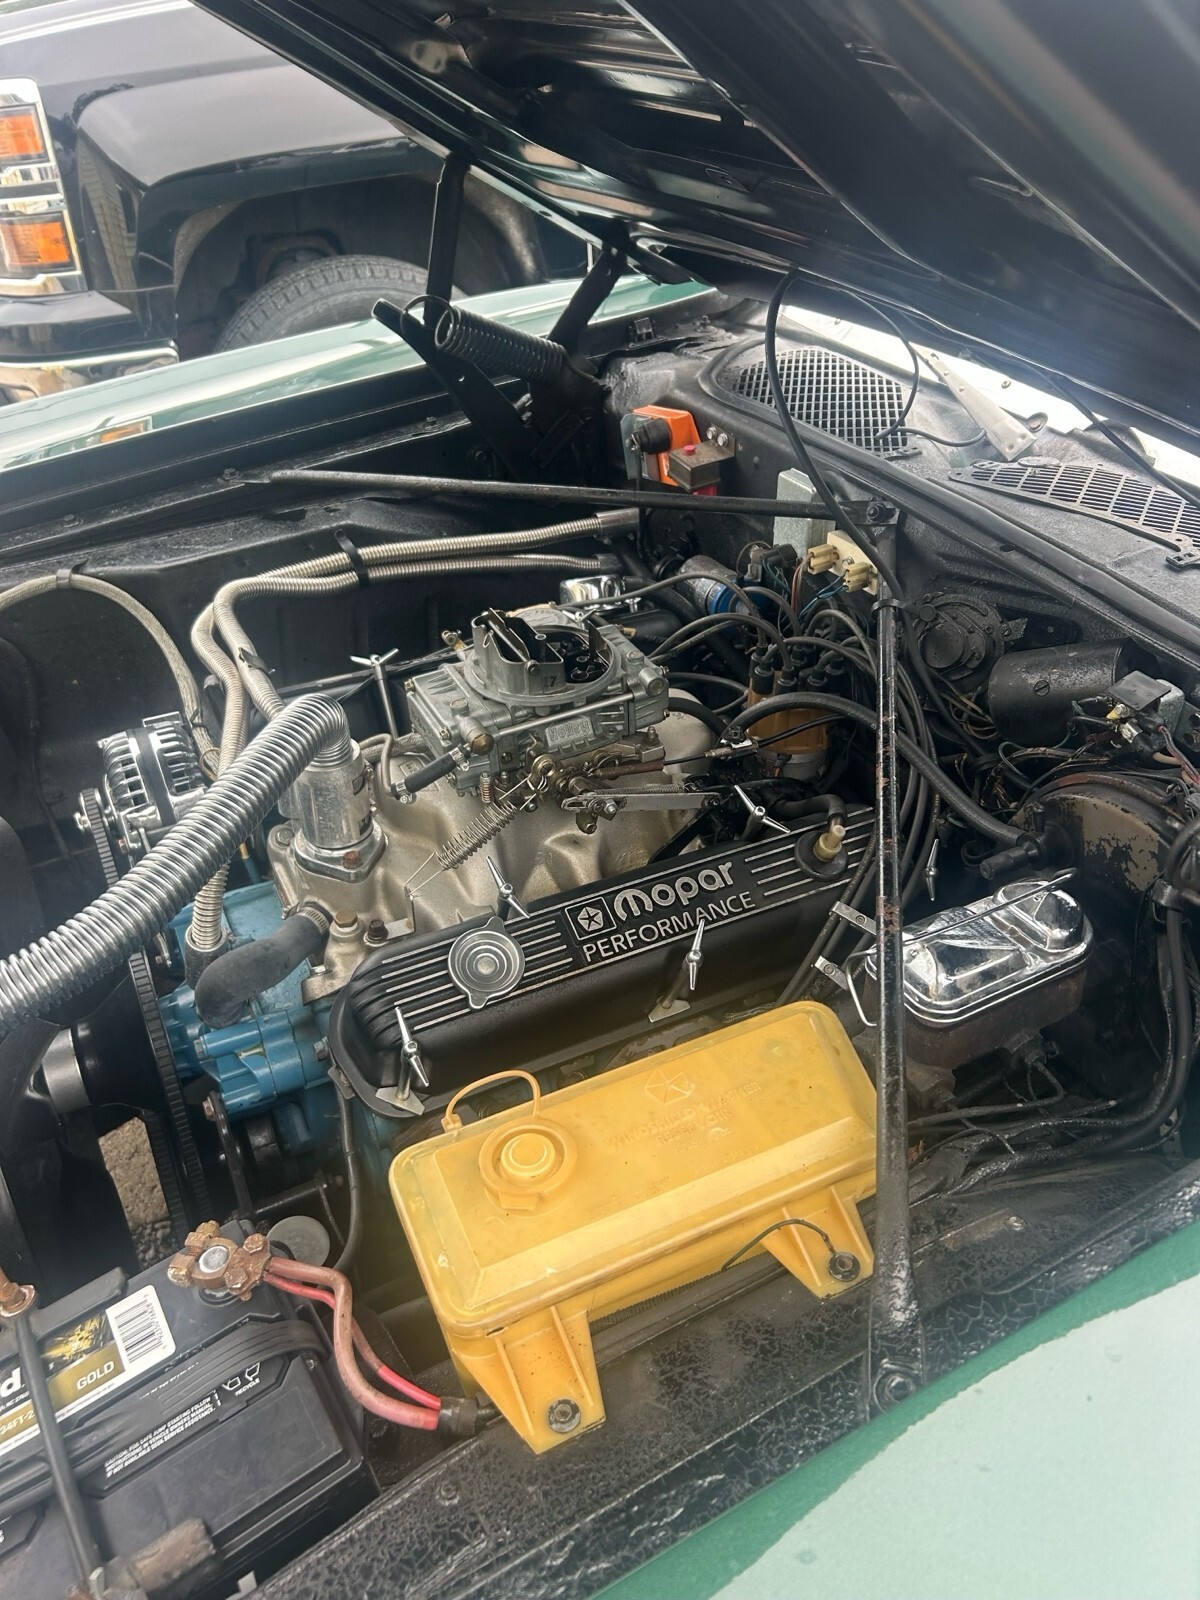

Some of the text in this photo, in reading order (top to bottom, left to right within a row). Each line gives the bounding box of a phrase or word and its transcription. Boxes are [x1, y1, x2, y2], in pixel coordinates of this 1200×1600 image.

[613, 861, 733, 922] Mopar
[582, 890, 756, 963] PERFORMANCE
[76, 1360, 115, 1390] GOLD
[235, 1377, 260, 1397] RECYCLE
